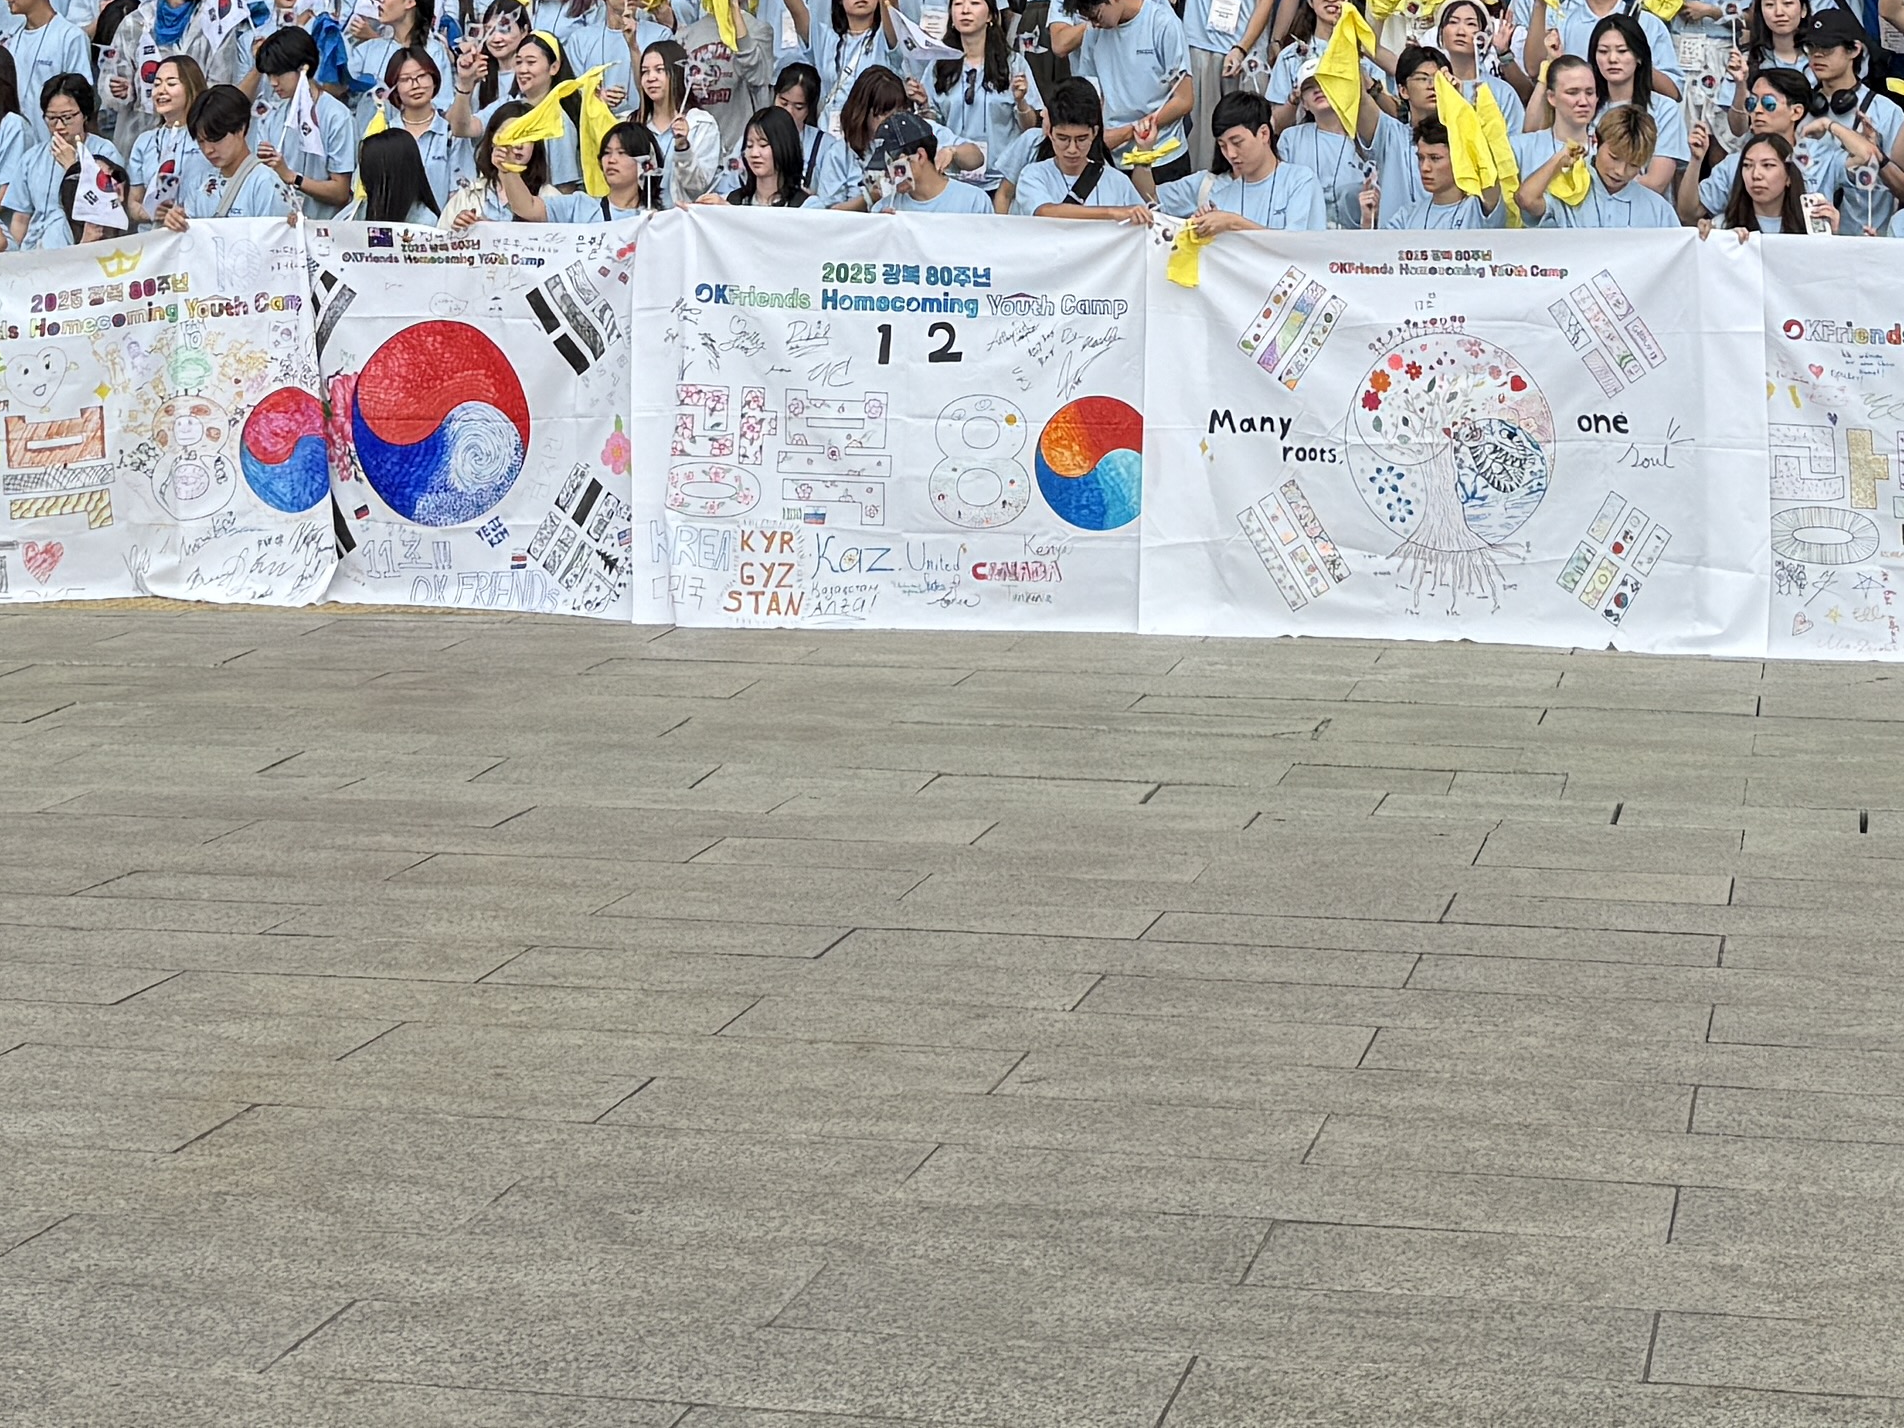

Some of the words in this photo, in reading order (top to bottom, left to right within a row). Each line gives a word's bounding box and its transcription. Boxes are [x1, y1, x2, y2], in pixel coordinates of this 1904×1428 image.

[404, 253, 474, 265] Homecoming
[512, 253, 545, 268] Camp
[1328, 262, 1394, 275] OKFriends
[1399, 263, 1486, 278] Homecoming
[1530, 264, 1569, 280] Camp
[822, 262, 877, 285] 2025
[882, 263, 920, 286] 광복
[925, 265, 992, 288] 80주년
[30, 289, 84, 314] 2025
[129, 271, 190, 300] 80주년
[695, 282, 811, 310] OKFriends
[821, 287, 979, 319] Homecoming
[986, 292, 1055, 317] Youth
[1061, 293, 1128, 320] Camp
[29, 301, 179, 339] Homecoming
[184, 294, 249, 319] Youth
[1208, 409, 1292, 441] Many
[1577, 412, 1629, 434] one
[488, 527, 510, 548] KIM
[740, 529, 795, 555] KYR
[740, 561, 796, 589] GYZ
[971, 560, 1064, 584] CANADA
[722, 590, 806, 617] STAN
